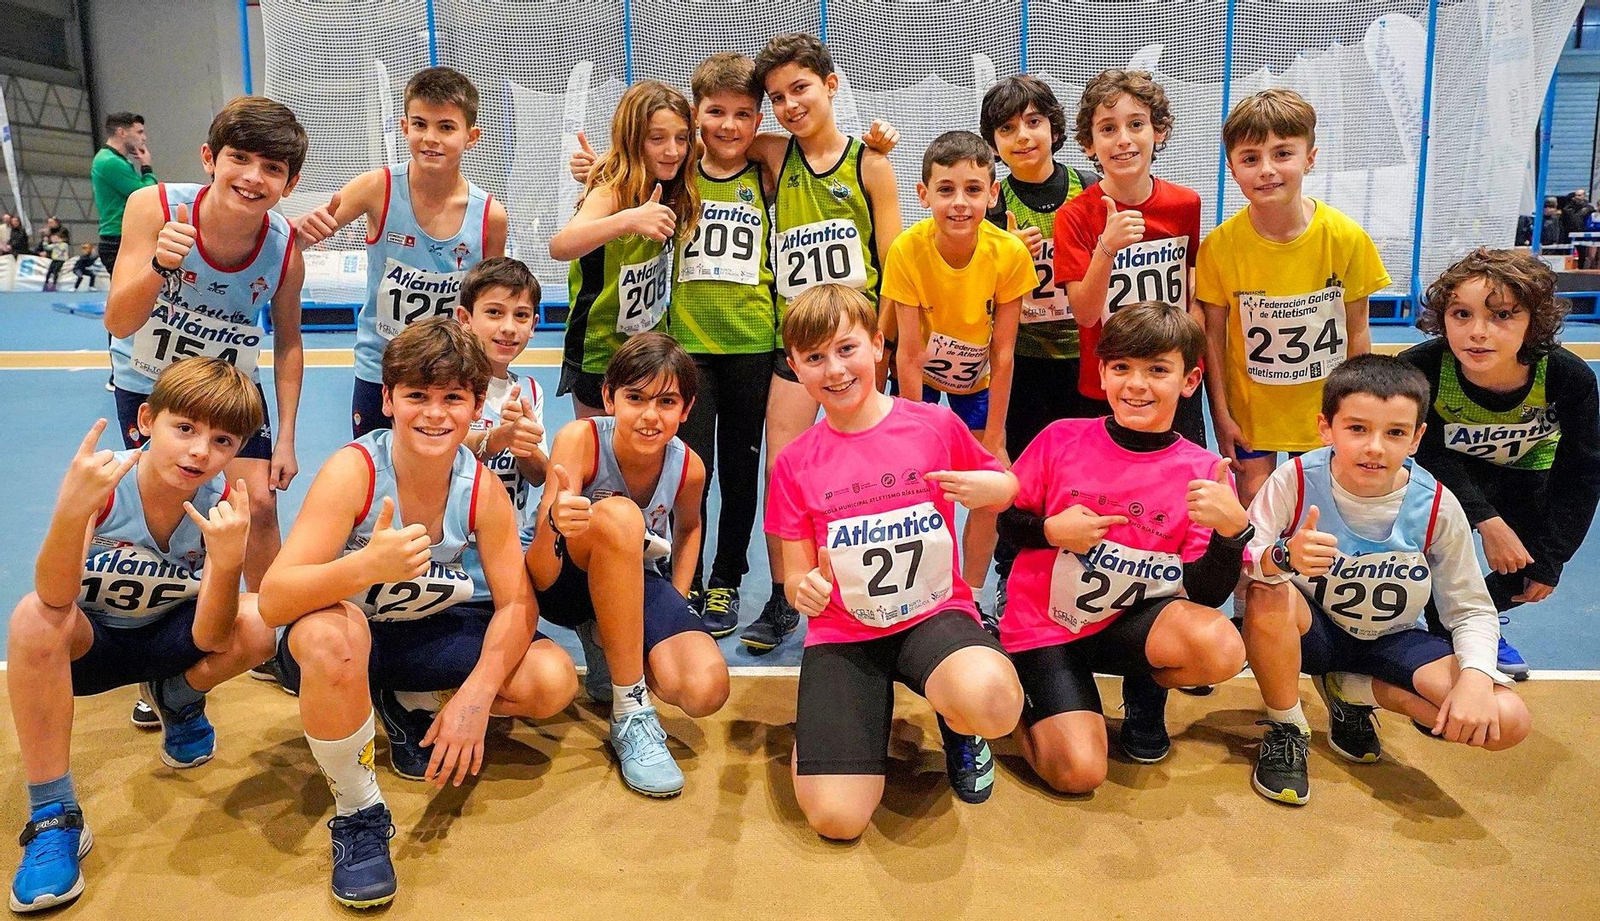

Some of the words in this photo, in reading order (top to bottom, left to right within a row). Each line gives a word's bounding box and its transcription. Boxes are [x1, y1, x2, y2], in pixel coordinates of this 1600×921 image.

[699, 202, 761, 226] lántico
[684, 223, 754, 260] 209
[780, 222, 857, 253] Atlántico
[787, 244, 851, 287] 210
[1113, 242, 1186, 270] tlántico
[386, 266, 462, 294] Atlántic
[626, 267, 667, 319] 208
[1108, 264, 1182, 313] 206
[1259, 298, 1306, 309] Federación
[1308, 290, 1342, 304] Galega
[1260, 311, 1269, 319] de
[1271, 306, 1318, 319] Atletismo
[150, 304, 260, 347] Atlántico
[1247, 318, 1343, 364] 234
[924, 359, 983, 383] 23
[1248, 366, 1308, 380] atletismo.gal
[838, 500, 869, 511] MUNICIPAL
[869, 492, 901, 504] ATLETISMO
[831, 511, 943, 549] Atlántico
[862, 540, 924, 598] 27
[1291, 555, 1429, 581] lántico
[1076, 570, 1147, 614] 24
[1308, 576, 1408, 621] 129
